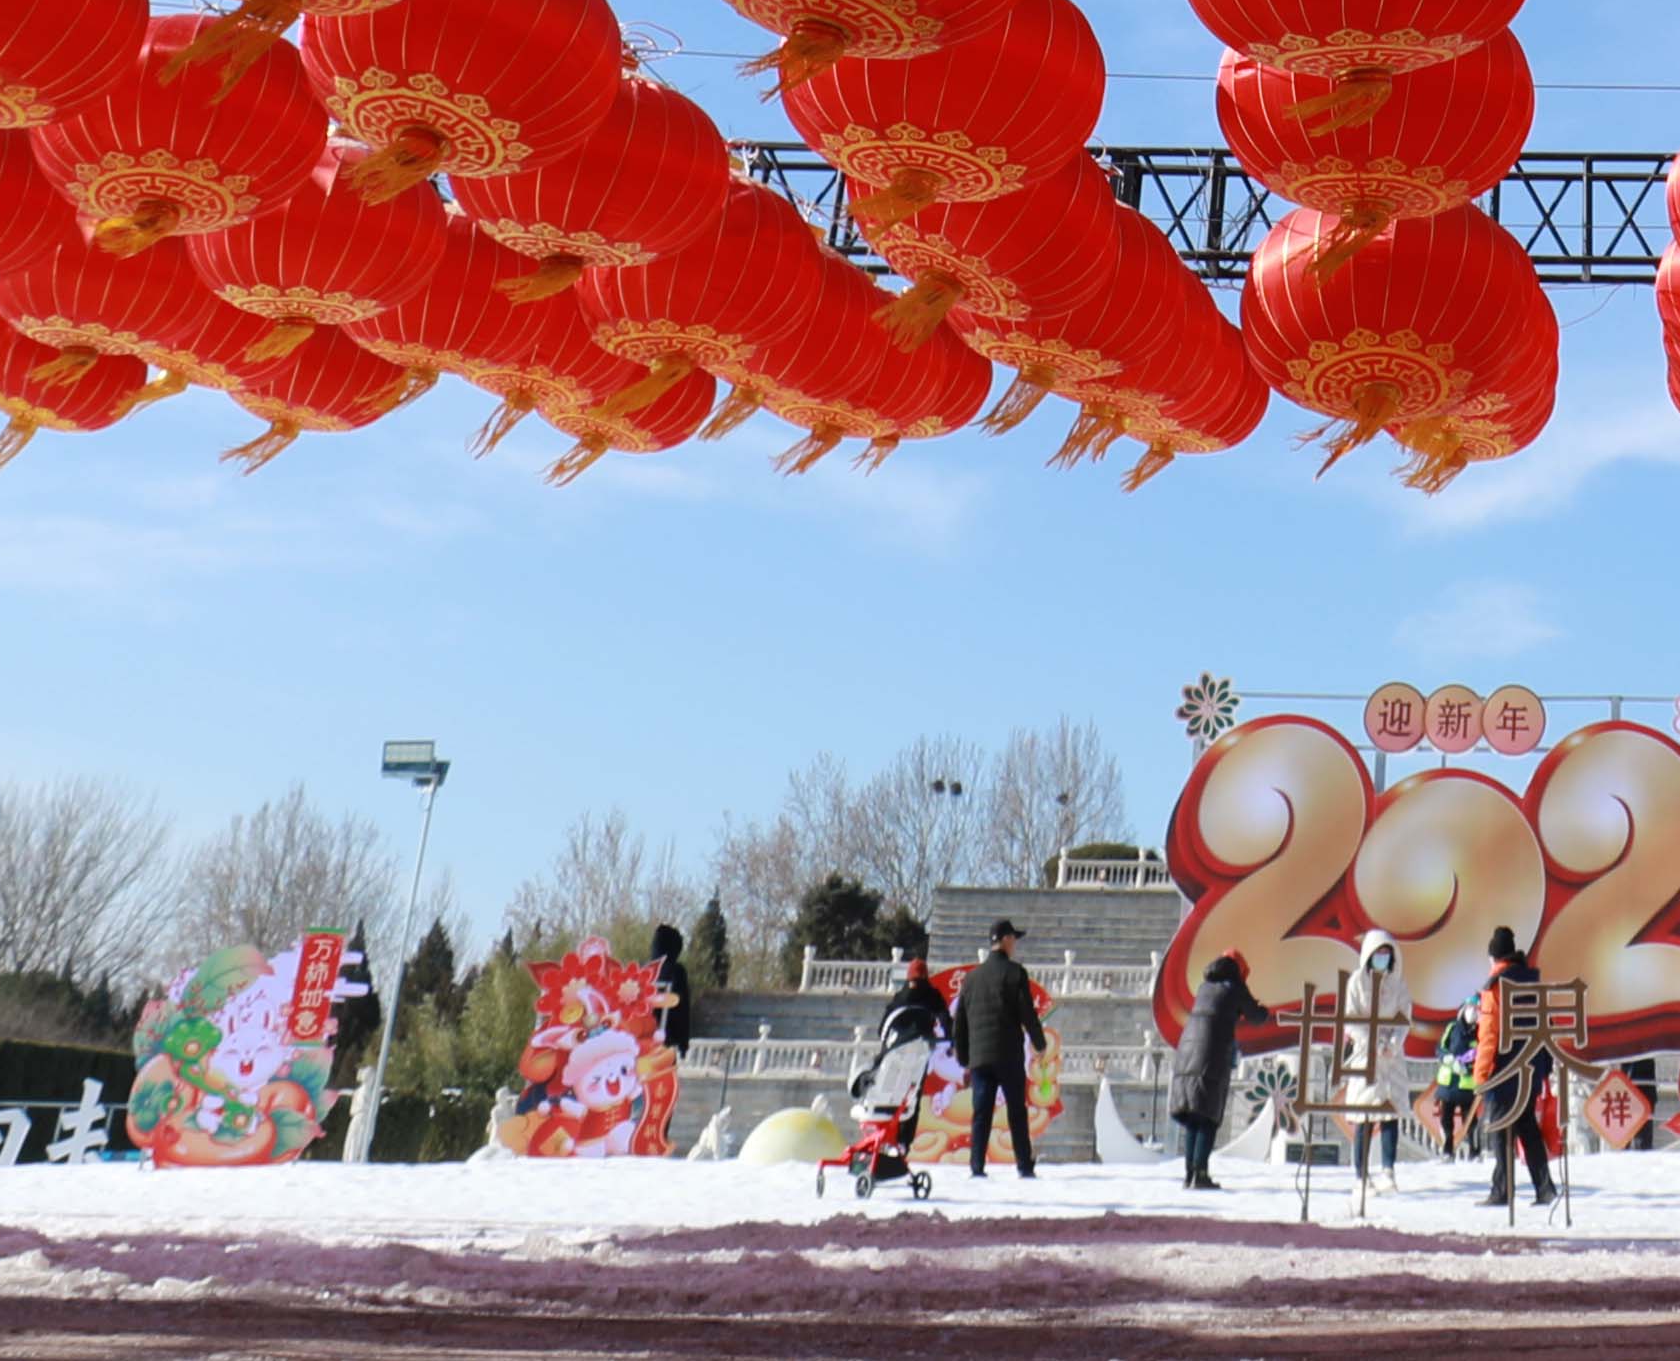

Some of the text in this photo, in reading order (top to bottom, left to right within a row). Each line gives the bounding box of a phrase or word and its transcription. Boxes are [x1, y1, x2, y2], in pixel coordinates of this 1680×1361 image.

[1376, 698, 1530, 742] 迎新年
[294, 938, 335, 1037] 万柿如意
[1600, 1089, 1633, 1128] 祥
